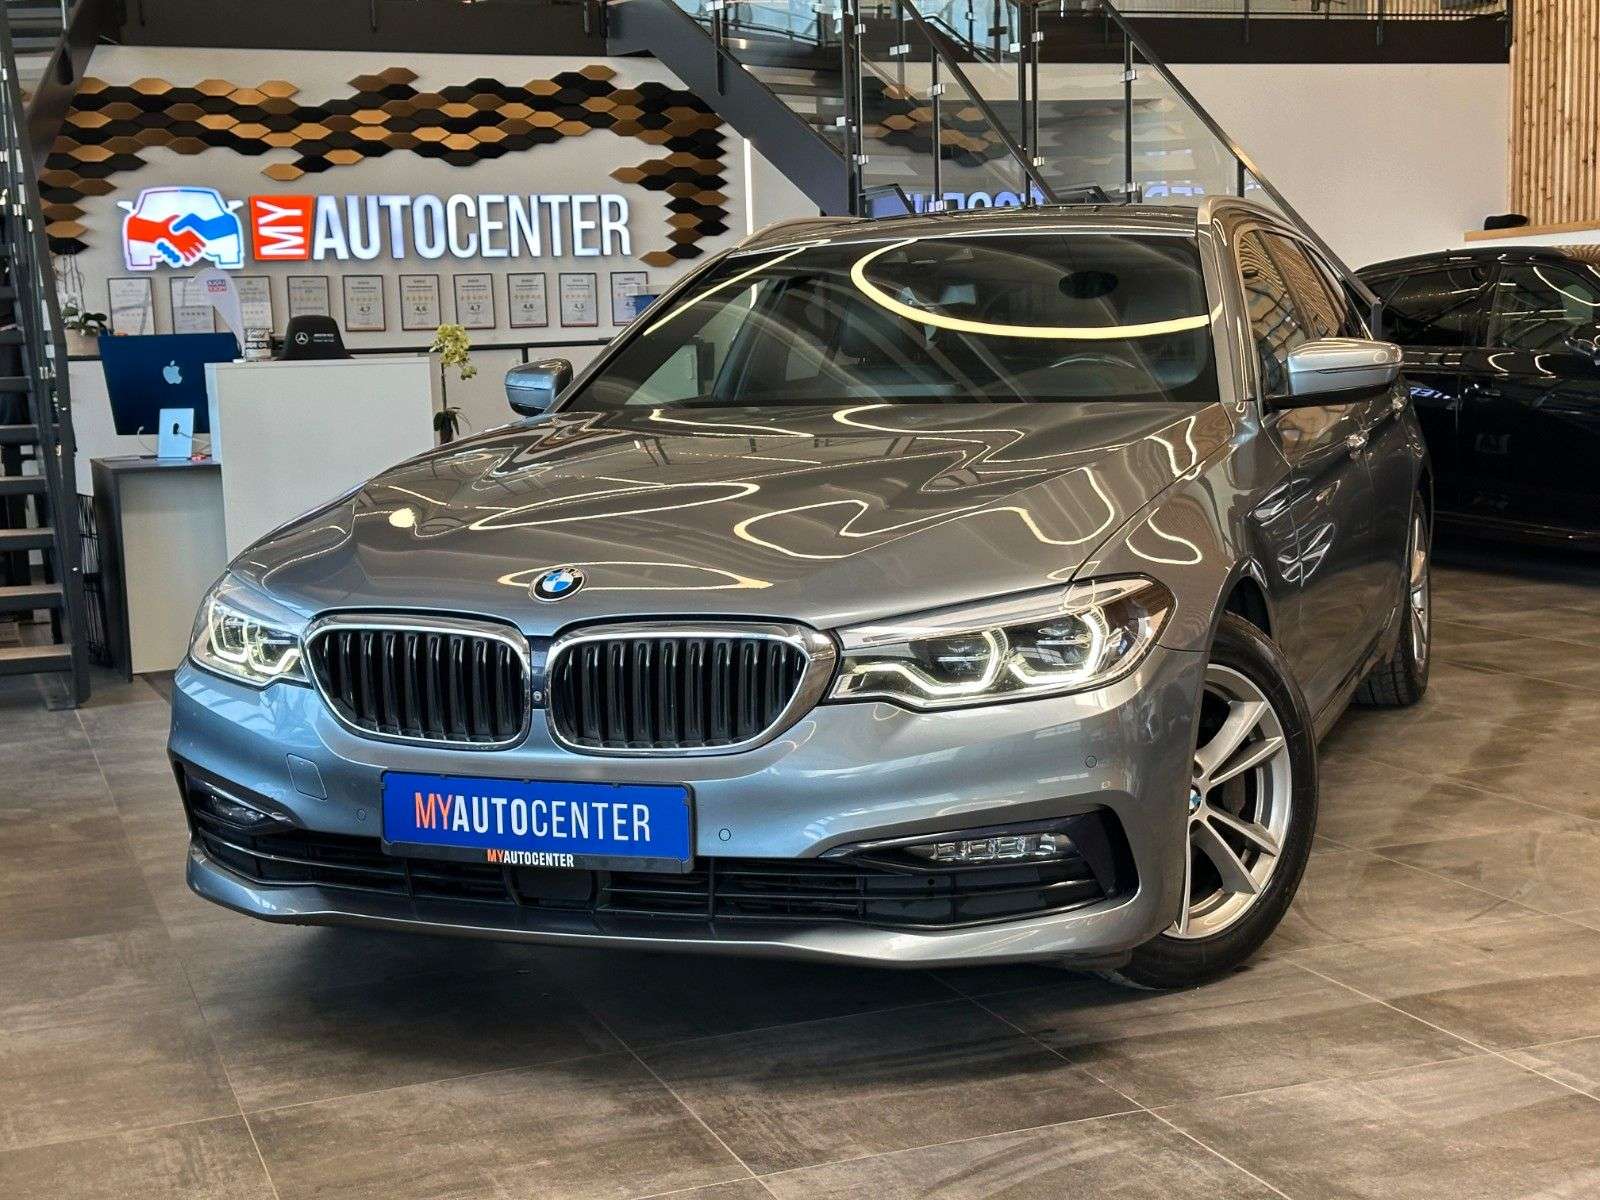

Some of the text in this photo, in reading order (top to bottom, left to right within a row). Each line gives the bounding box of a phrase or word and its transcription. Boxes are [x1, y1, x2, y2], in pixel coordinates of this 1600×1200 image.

[256, 193, 632, 260] MY AUTOCENTER
[414, 791, 651, 842] MYAUTOCENTER
[487, 848, 574, 868] MYAUTOCENTER
